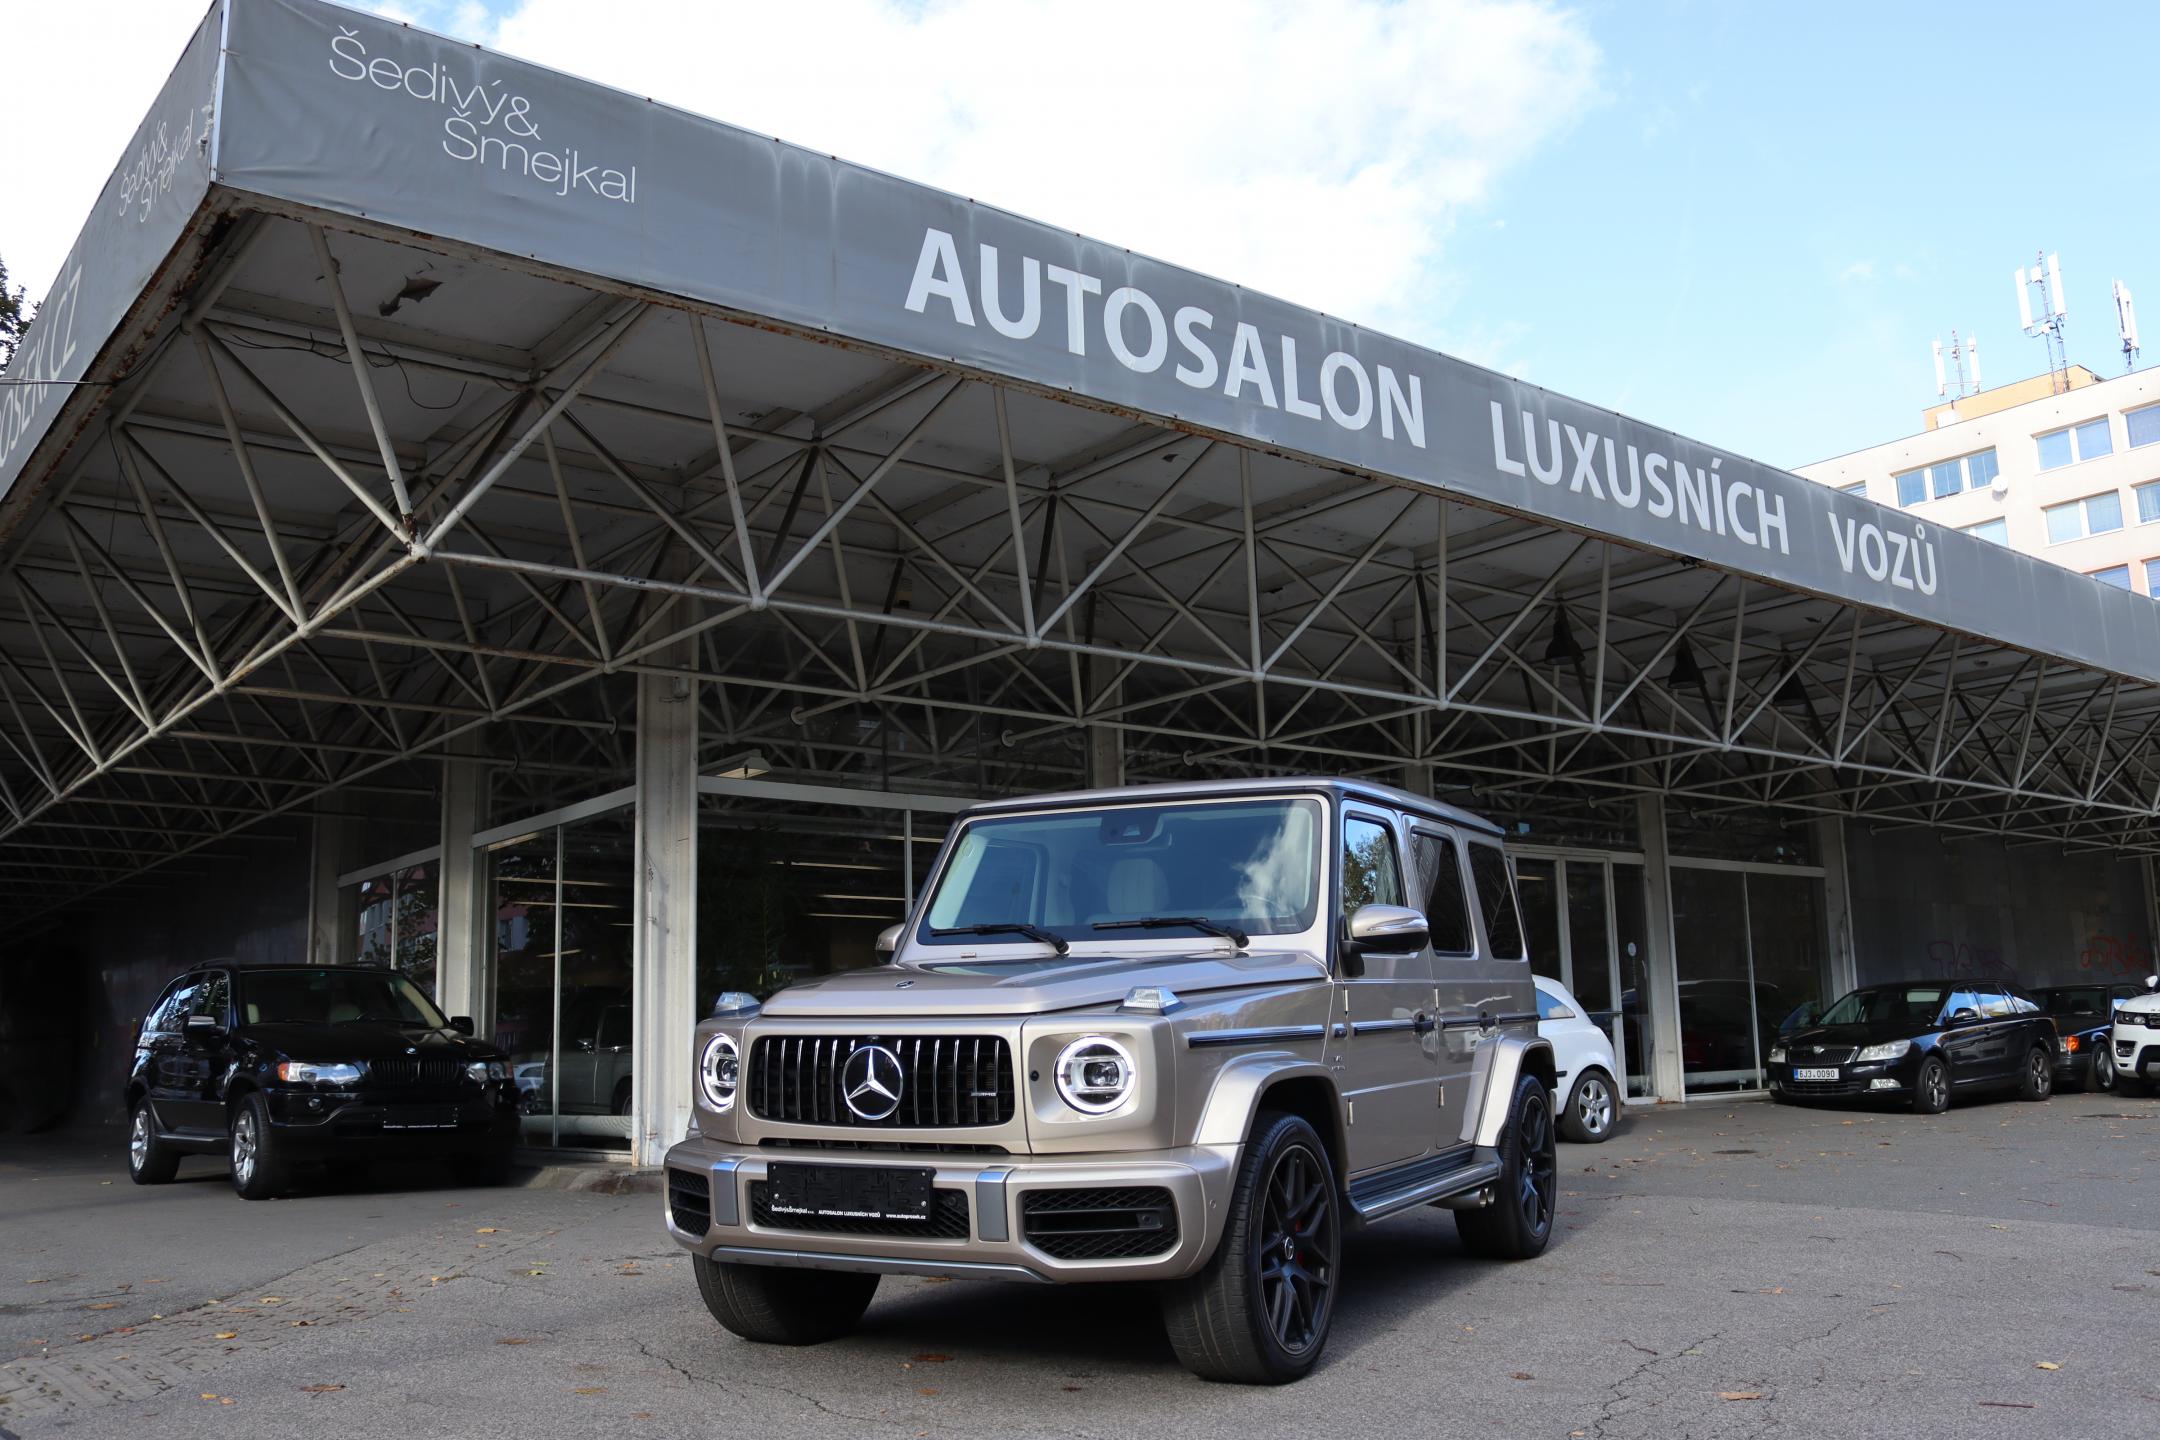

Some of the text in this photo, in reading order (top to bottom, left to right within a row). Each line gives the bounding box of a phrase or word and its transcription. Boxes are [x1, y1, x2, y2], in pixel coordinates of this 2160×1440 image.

[328, 25, 541, 140] Šedivý&
[442, 106, 637, 203] Šmejkal
[904, 227, 1938, 596] AUTOSALON LUXUSNÍCH VOZŮ
